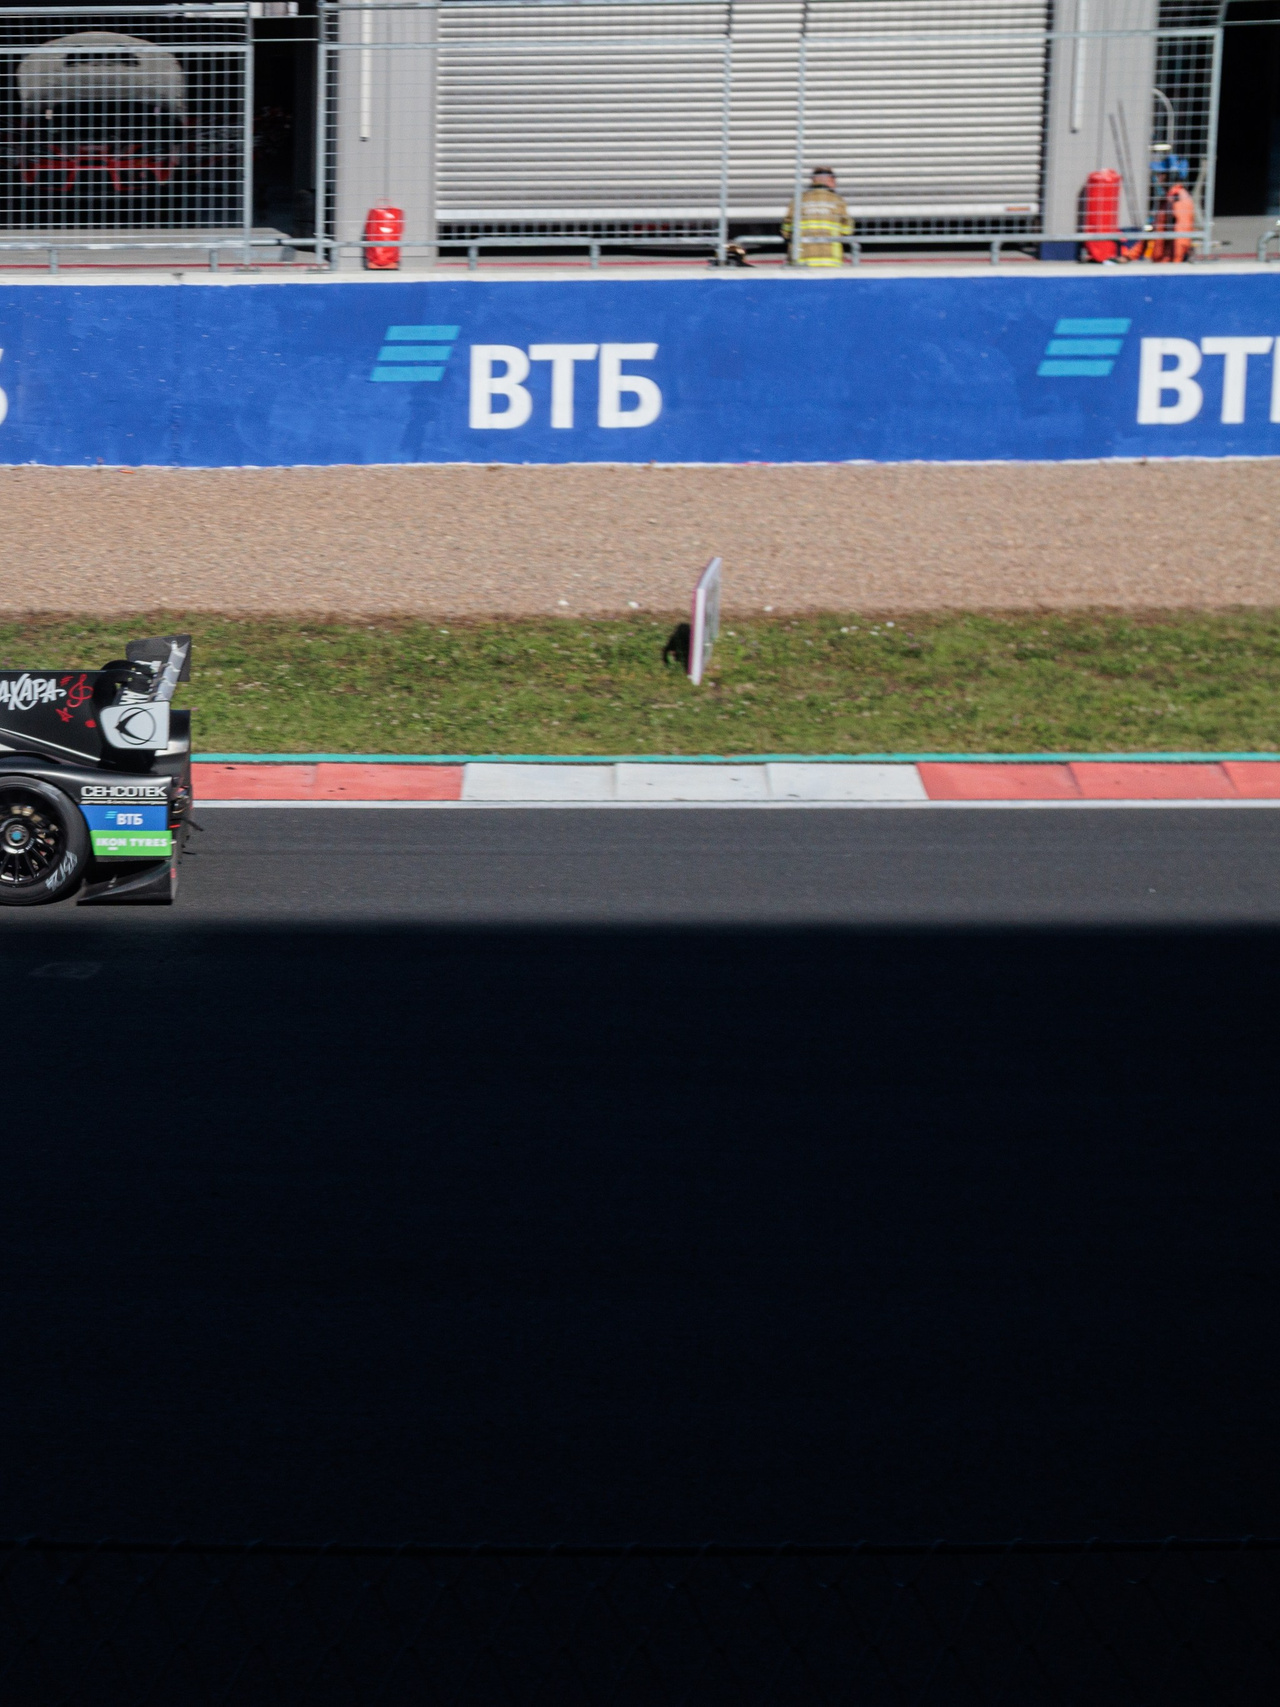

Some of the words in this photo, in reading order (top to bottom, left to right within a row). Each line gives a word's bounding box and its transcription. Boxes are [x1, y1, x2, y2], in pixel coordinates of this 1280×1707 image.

[469, 342, 662, 430] ВТБ
[1137, 336, 1280, 425] ВТ
[80, 785, 168, 797] СЕНСОТЕК
[116, 813, 144, 825] ВТБ
[95, 838, 127, 848] IKON
[129, 838, 168, 847] TYRES
